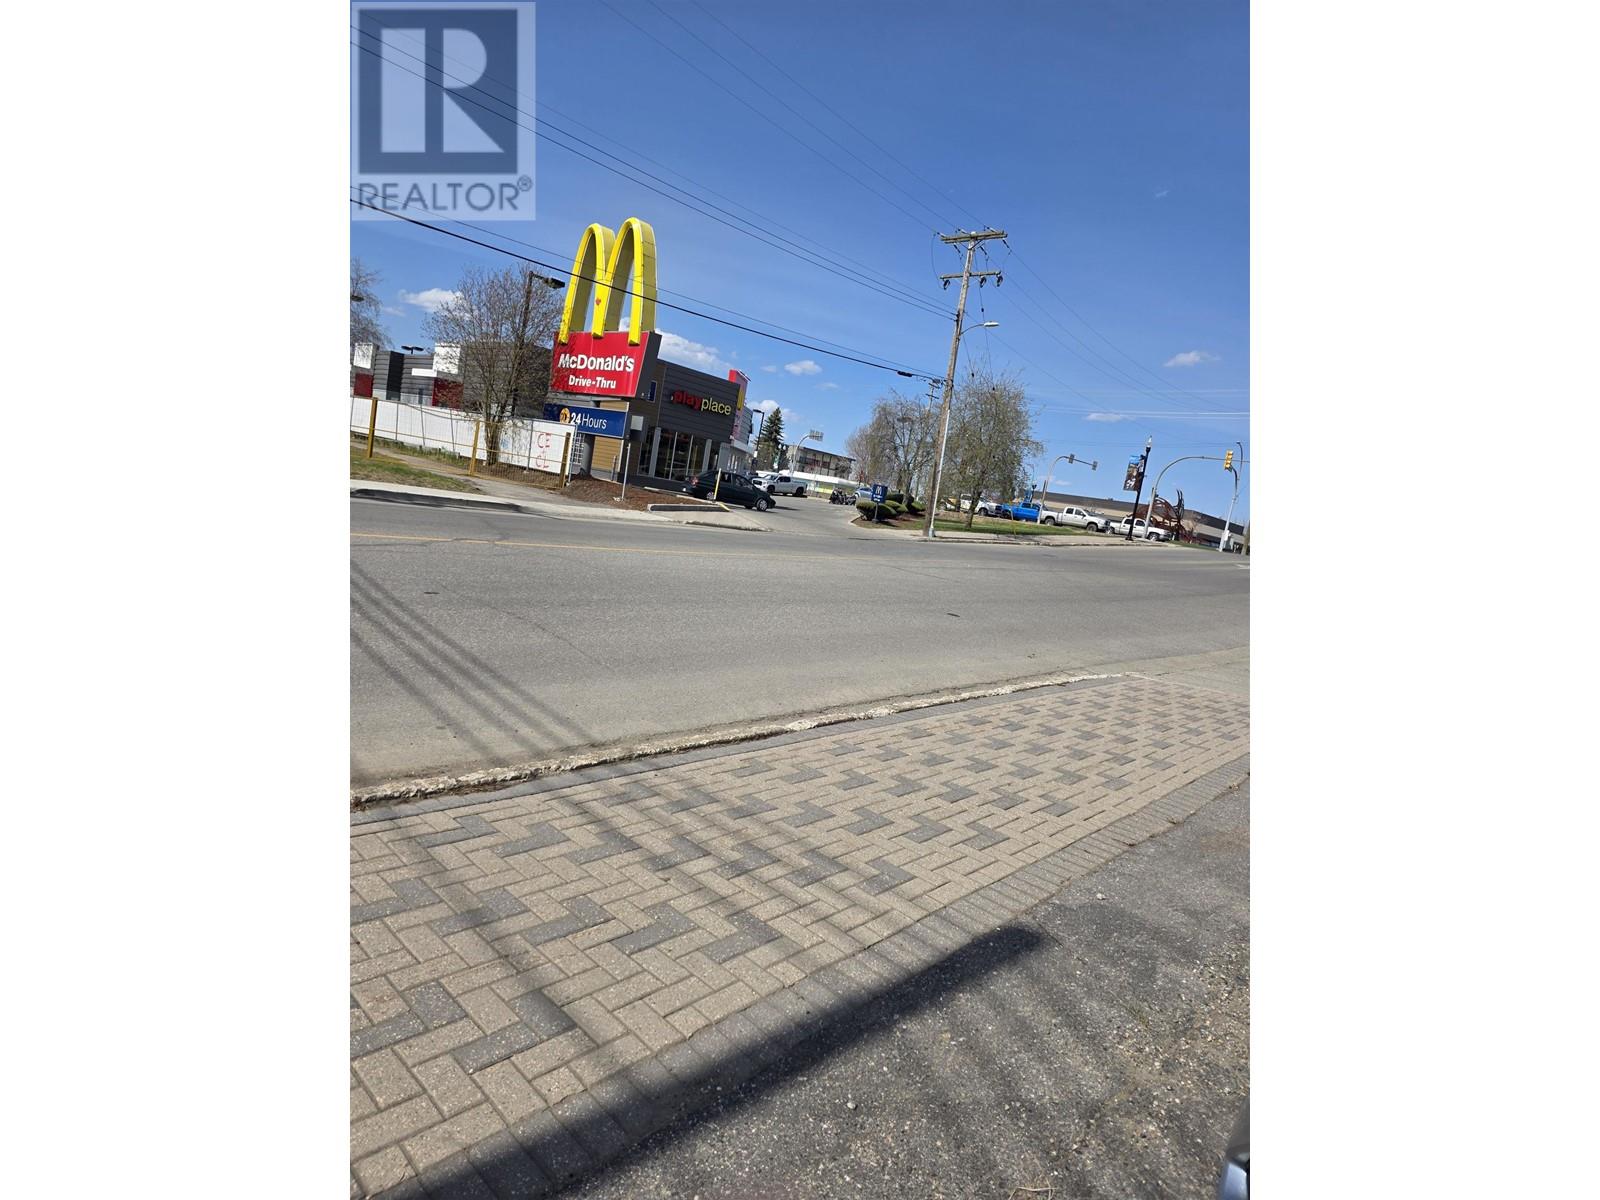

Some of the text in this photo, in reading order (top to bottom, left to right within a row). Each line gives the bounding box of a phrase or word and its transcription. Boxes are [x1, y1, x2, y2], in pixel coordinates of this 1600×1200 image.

[558, 353, 634, 372] McDonald's
[568, 374, 616, 389] Drive-Thru
[570, 412, 608, 430] 24 Hours
